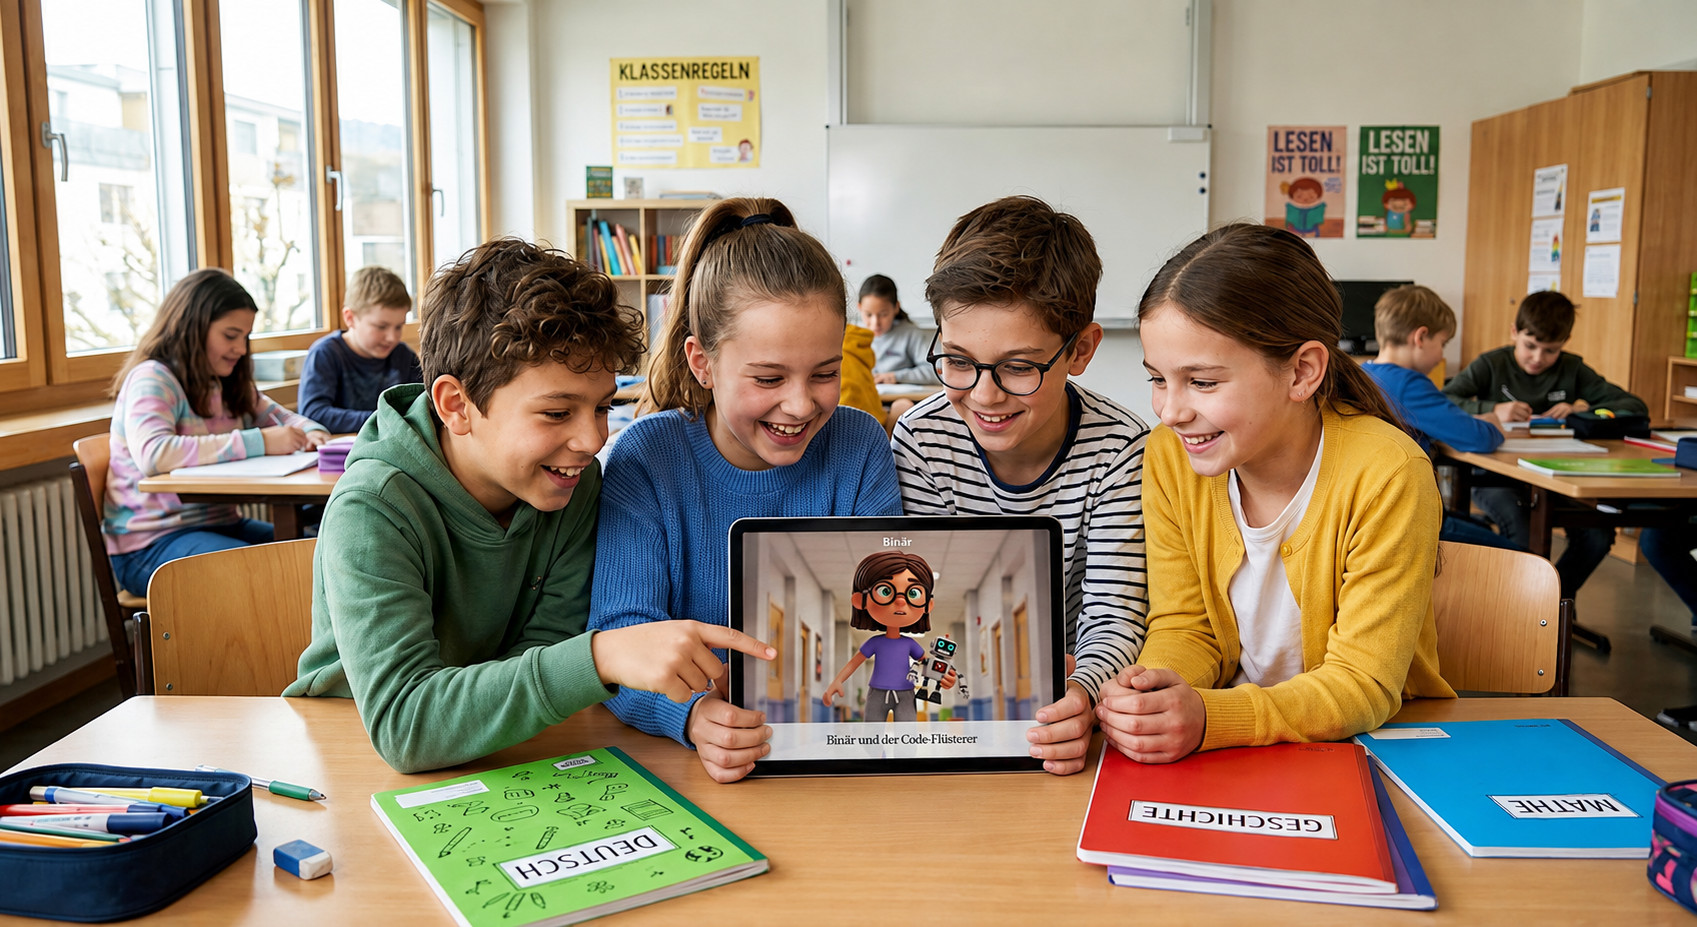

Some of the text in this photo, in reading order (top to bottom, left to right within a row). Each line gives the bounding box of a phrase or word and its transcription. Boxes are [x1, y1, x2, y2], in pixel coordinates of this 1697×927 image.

[619, 62, 750, 80] KLASSENREGELN
[1273, 130, 1333, 153] LESEN
[1368, 129, 1430, 154] LESEN
[1271, 154, 1341, 174] IST TOLL!
[1361, 154, 1436, 175] IST TOLL!
[882, 536, 913, 547] Binär
[826, 733, 978, 746] Binär und der Code-Flüsterer
[1508, 798, 1620, 814] MATHE
[1142, 805, 1324, 834] GESCHICHTE
[514, 832, 659, 880] DEUTSCH
